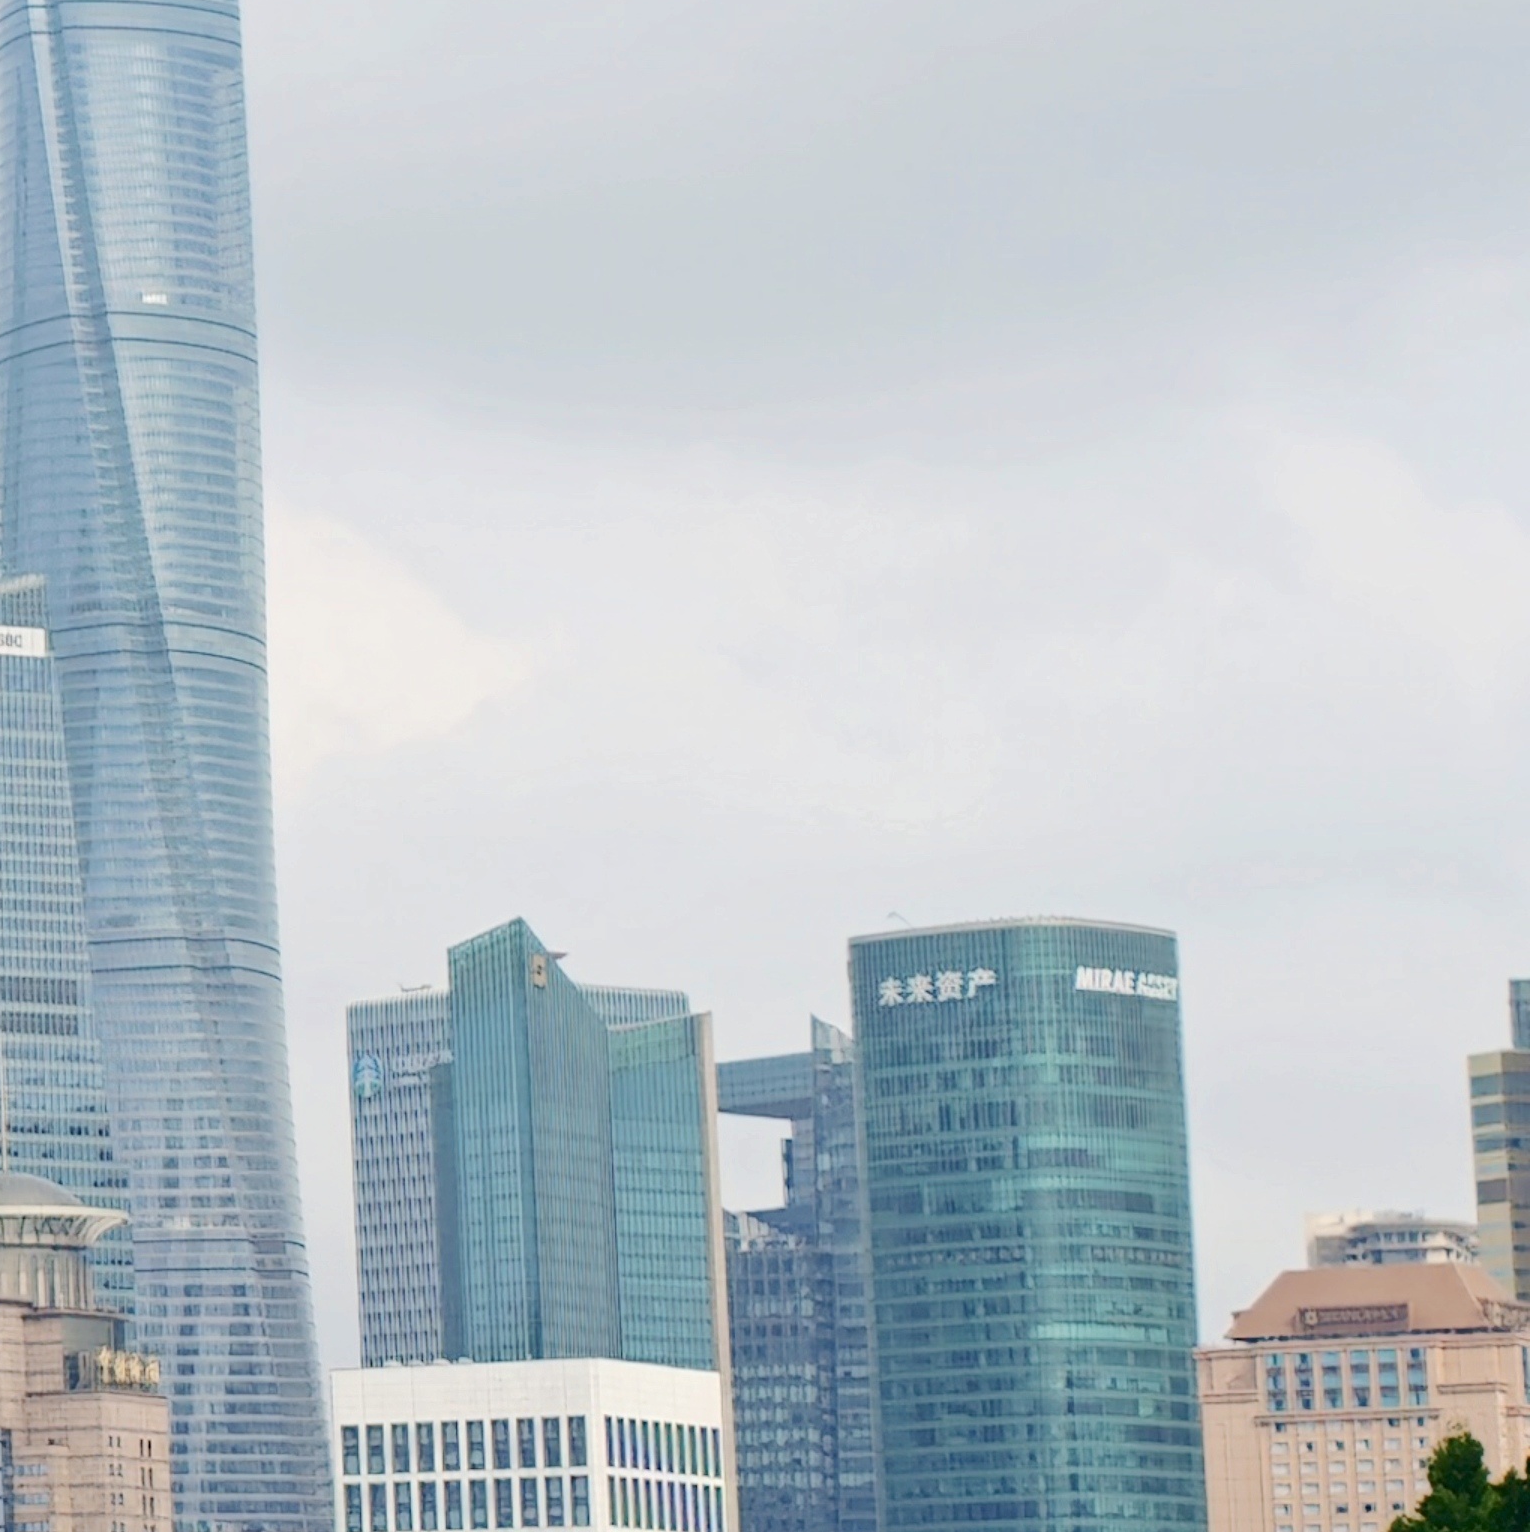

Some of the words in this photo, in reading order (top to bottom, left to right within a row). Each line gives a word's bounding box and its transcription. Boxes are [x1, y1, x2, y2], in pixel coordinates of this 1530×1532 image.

[878, 967, 998, 1007] 未来资产
[1075, 965, 1135, 996] MIRAE
